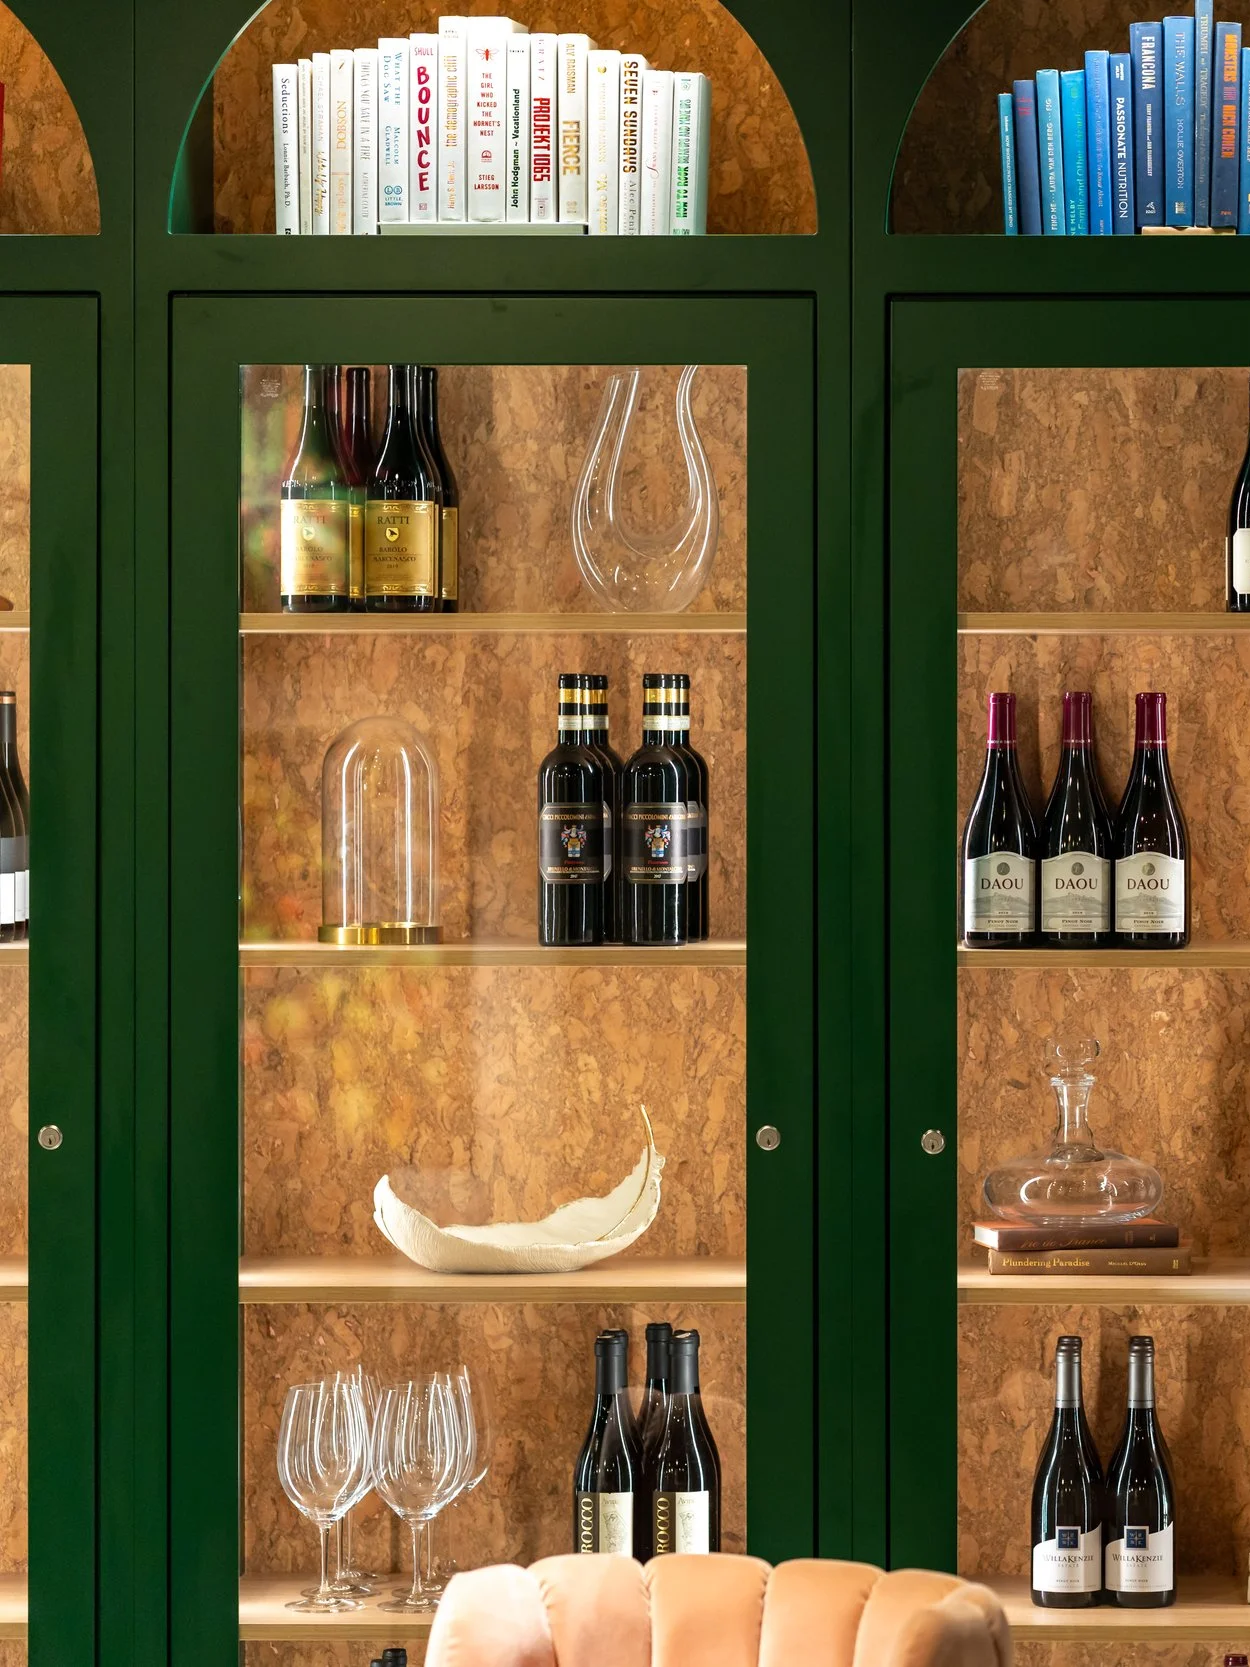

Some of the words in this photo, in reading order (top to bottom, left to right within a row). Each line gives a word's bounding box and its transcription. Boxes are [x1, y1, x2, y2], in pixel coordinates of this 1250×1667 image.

[1175, 31, 1185, 58] THE
[1199, 14, 1208, 54] TRIUMPH
[414, 46, 434, 56] SHULL
[566, 43, 576, 56] ALY
[1141, 35, 1156, 89] FRANCONA
[1223, 34, 1237, 82] MONSTERS
[360, 60, 370, 86] THINGS
[482, 72, 492, 80] THE
[566, 58, 576, 94] RAISMAN
[623, 60, 639, 104] SEVEN
[1175, 60, 1185, 105] WALLS
[360, 89, 370, 104] YOU
[1199, 68, 1208, 108] TRAGEDY
[280, 78, 290, 134] Seductions
[360, 106, 370, 122] SAVE
[444, 76, 458, 130] demographic
[510, 88, 520, 140] Vacationland
[336, 100, 346, 150] DOBSON
[416, 66, 431, 192] BOUNCE
[534, 97, 551, 152] PROJEKT
[1116, 96, 1126, 158] PASSIONATE
[1176, 117, 1184, 148] HOLLIE
[282, 142, 290, 164] Lonnie
[360, 144, 370, 160] FIRE
[444, 134, 458, 148] the
[562, 120, 581, 176] FIERCE
[623, 110, 639, 173] SUNDAYS
[1220, 128, 1236, 159] COHEN
[510, 149, 520, 188] Hodgman
[534, 154, 551, 182] 1065
[678, 166, 689, 188] ROCK
[1176, 149, 1184, 188] OVERTON
[510, 188, 520, 208] John
[676, 190, 688, 201] TO
[1118, 161, 1128, 217] NUTRITION
[676, 202, 688, 219] HOW
[1050, 203, 1057, 213] ME
[294, 514, 326, 525] RATTI
[377, 516, 410, 525] RATTI
[981, 878, 1024, 890] DAOU
[1055, 878, 1098, 890] DAOU
[1127, 878, 1170, 890] DAOU
[1064, 1237, 1107, 1247] France
[1002, 1258, 1051, 1268] Plundering
[1052, 1258, 1090, 1267] Paradise
[580, 1498, 594, 1554] ROCCO
[656, 1497, 670, 1553] ROCCO
[1042, 1554, 1094, 1564] WILLAKENZIE
[1112, 1552, 1163, 1563] WILLAKENZIE
